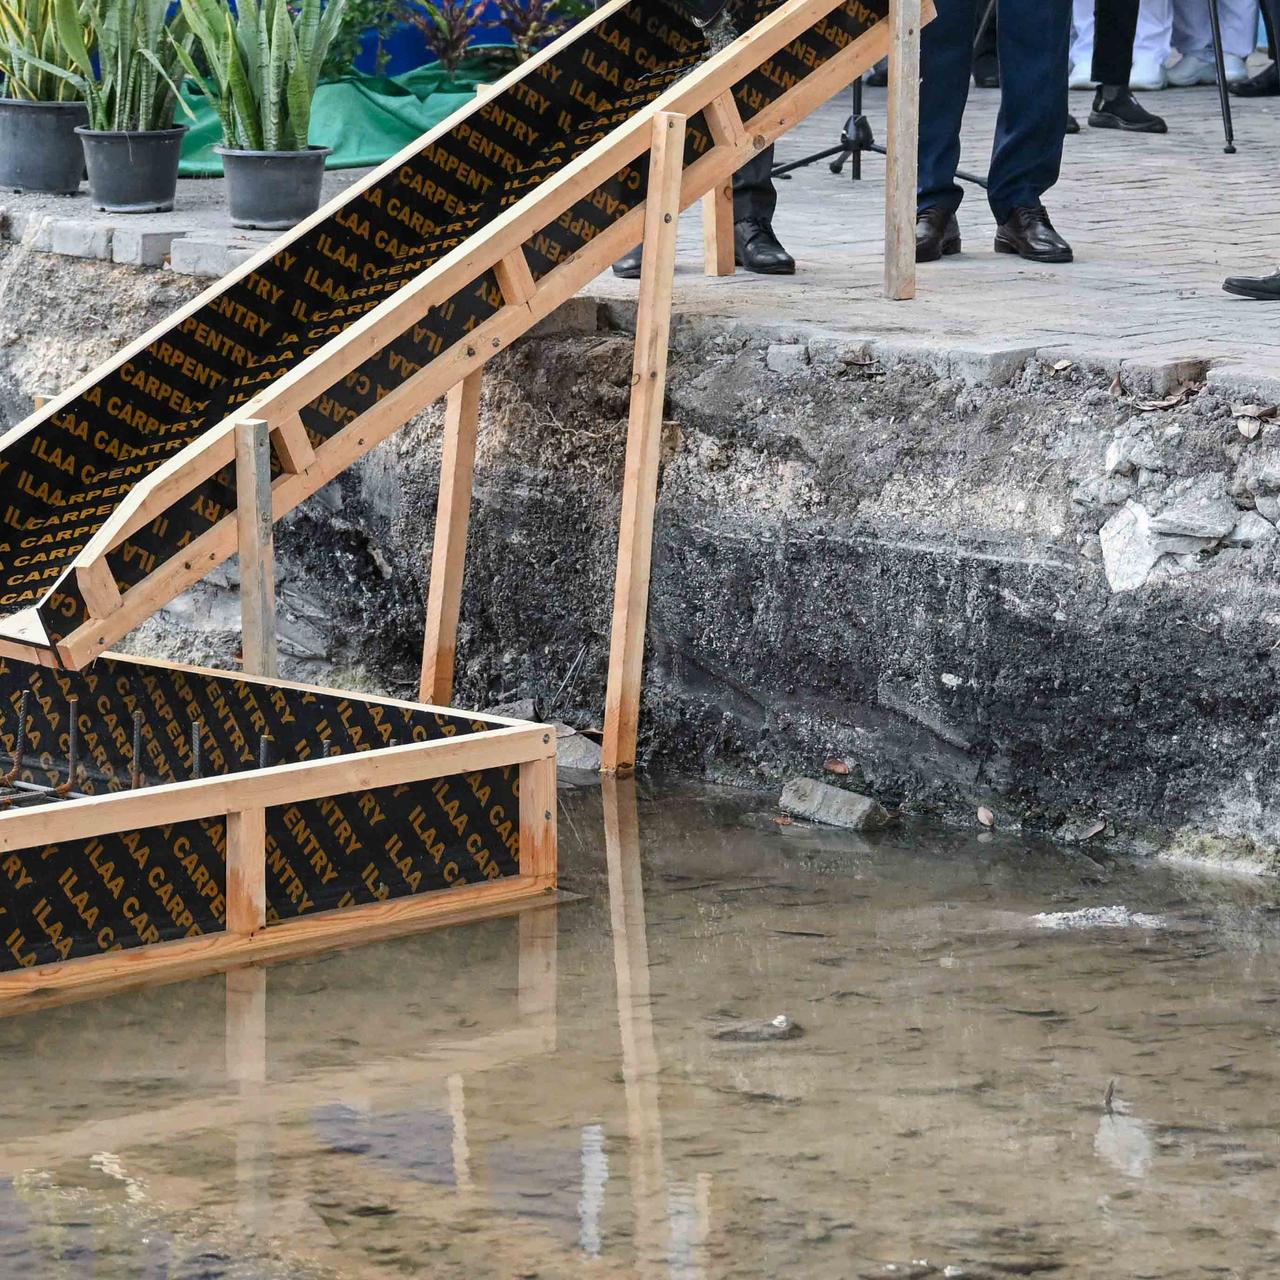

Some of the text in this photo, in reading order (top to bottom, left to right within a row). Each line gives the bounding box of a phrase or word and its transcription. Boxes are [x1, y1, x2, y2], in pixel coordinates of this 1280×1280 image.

[582, 49, 619, 86] ILAA
[316, 233, 359, 273] ILAA
[31, 436, 76, 476] ILAA
[29, 672, 60, 731] ILAA
[408, 804, 446, 865] ILAA
[432, 779, 470, 838] ILAA
[83, 838, 125, 900] ILAA
[384, 833, 424, 893] ILAA
[58, 866, 100, 930] ILAA
[32, 897, 74, 961] ILAA
